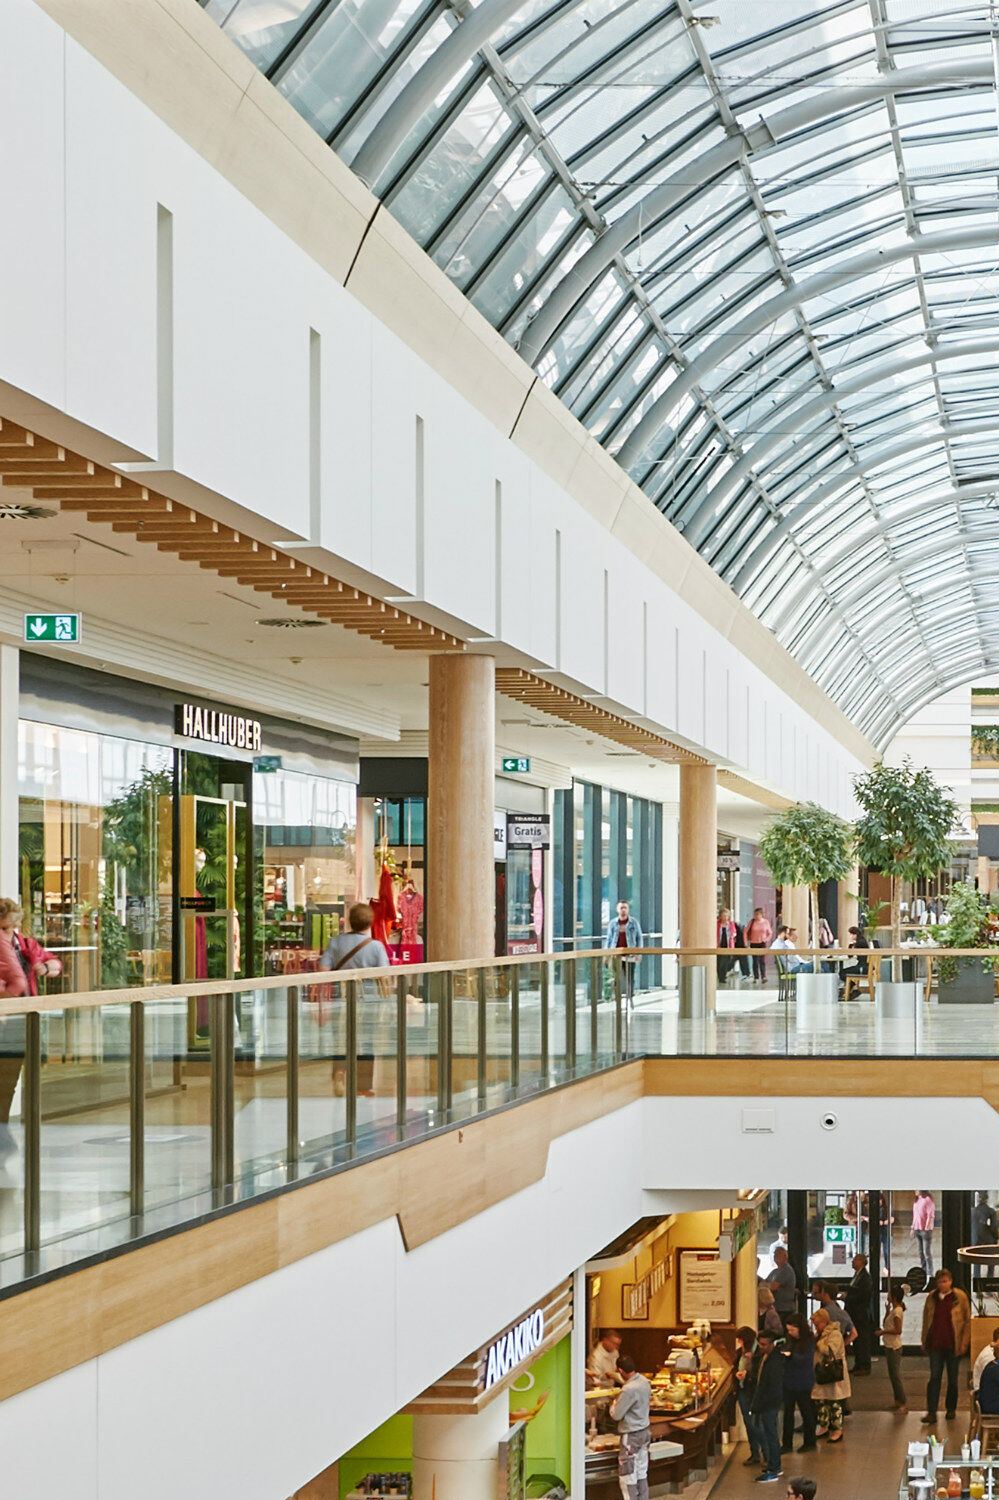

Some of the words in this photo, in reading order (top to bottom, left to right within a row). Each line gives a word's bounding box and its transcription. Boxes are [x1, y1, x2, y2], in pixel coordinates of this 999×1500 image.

[183, 703, 262, 751] HALLHUBER
[514, 826, 542, 836] Gratis
[264, 952, 322, 961] MIDSE
[393, 951, 411, 961] LE
[485, 1308, 544, 1392] AKAKIKO
